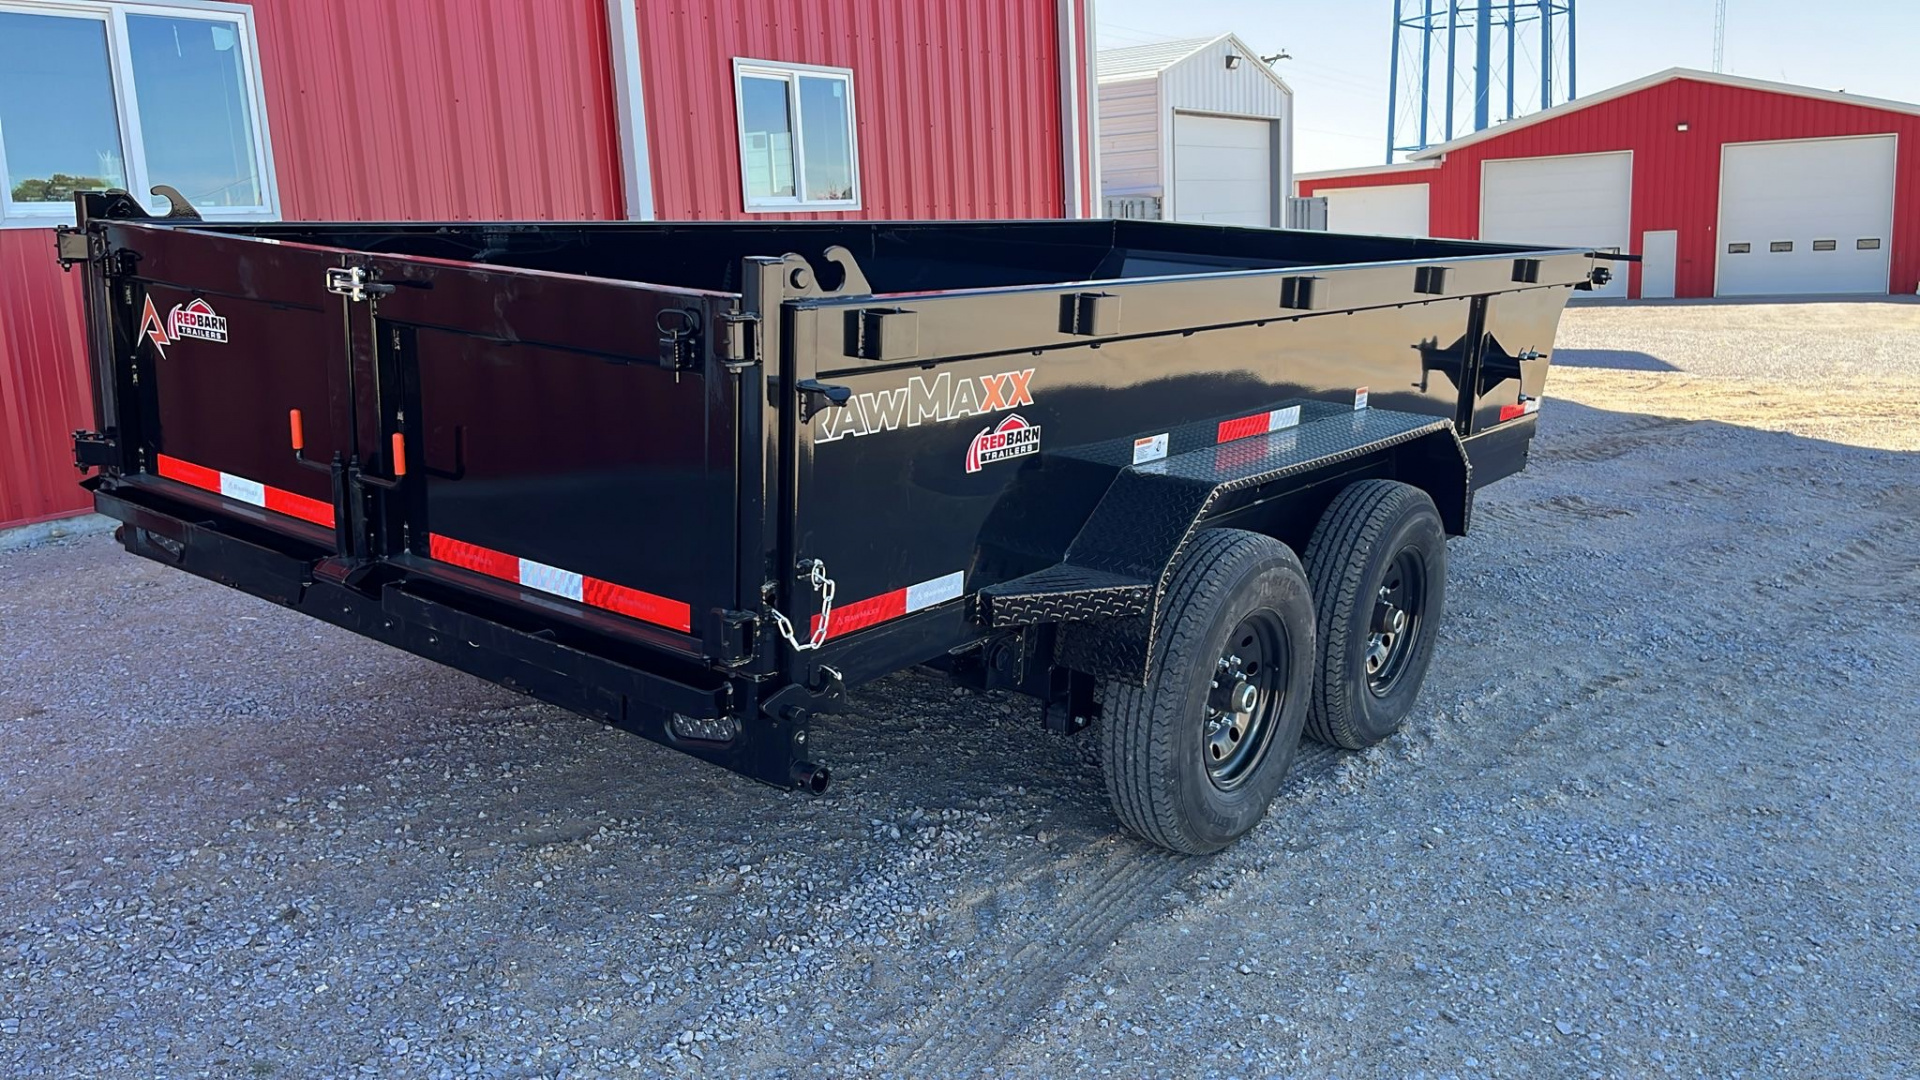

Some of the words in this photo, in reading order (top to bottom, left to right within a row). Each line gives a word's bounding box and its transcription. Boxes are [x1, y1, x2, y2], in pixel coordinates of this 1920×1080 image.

[176, 311, 226, 331] REDBARN
[181, 327, 221, 339] TRAILERS
[980, 427, 1040, 451] REDBARN
[985, 444, 1033, 460] TRAILERS
